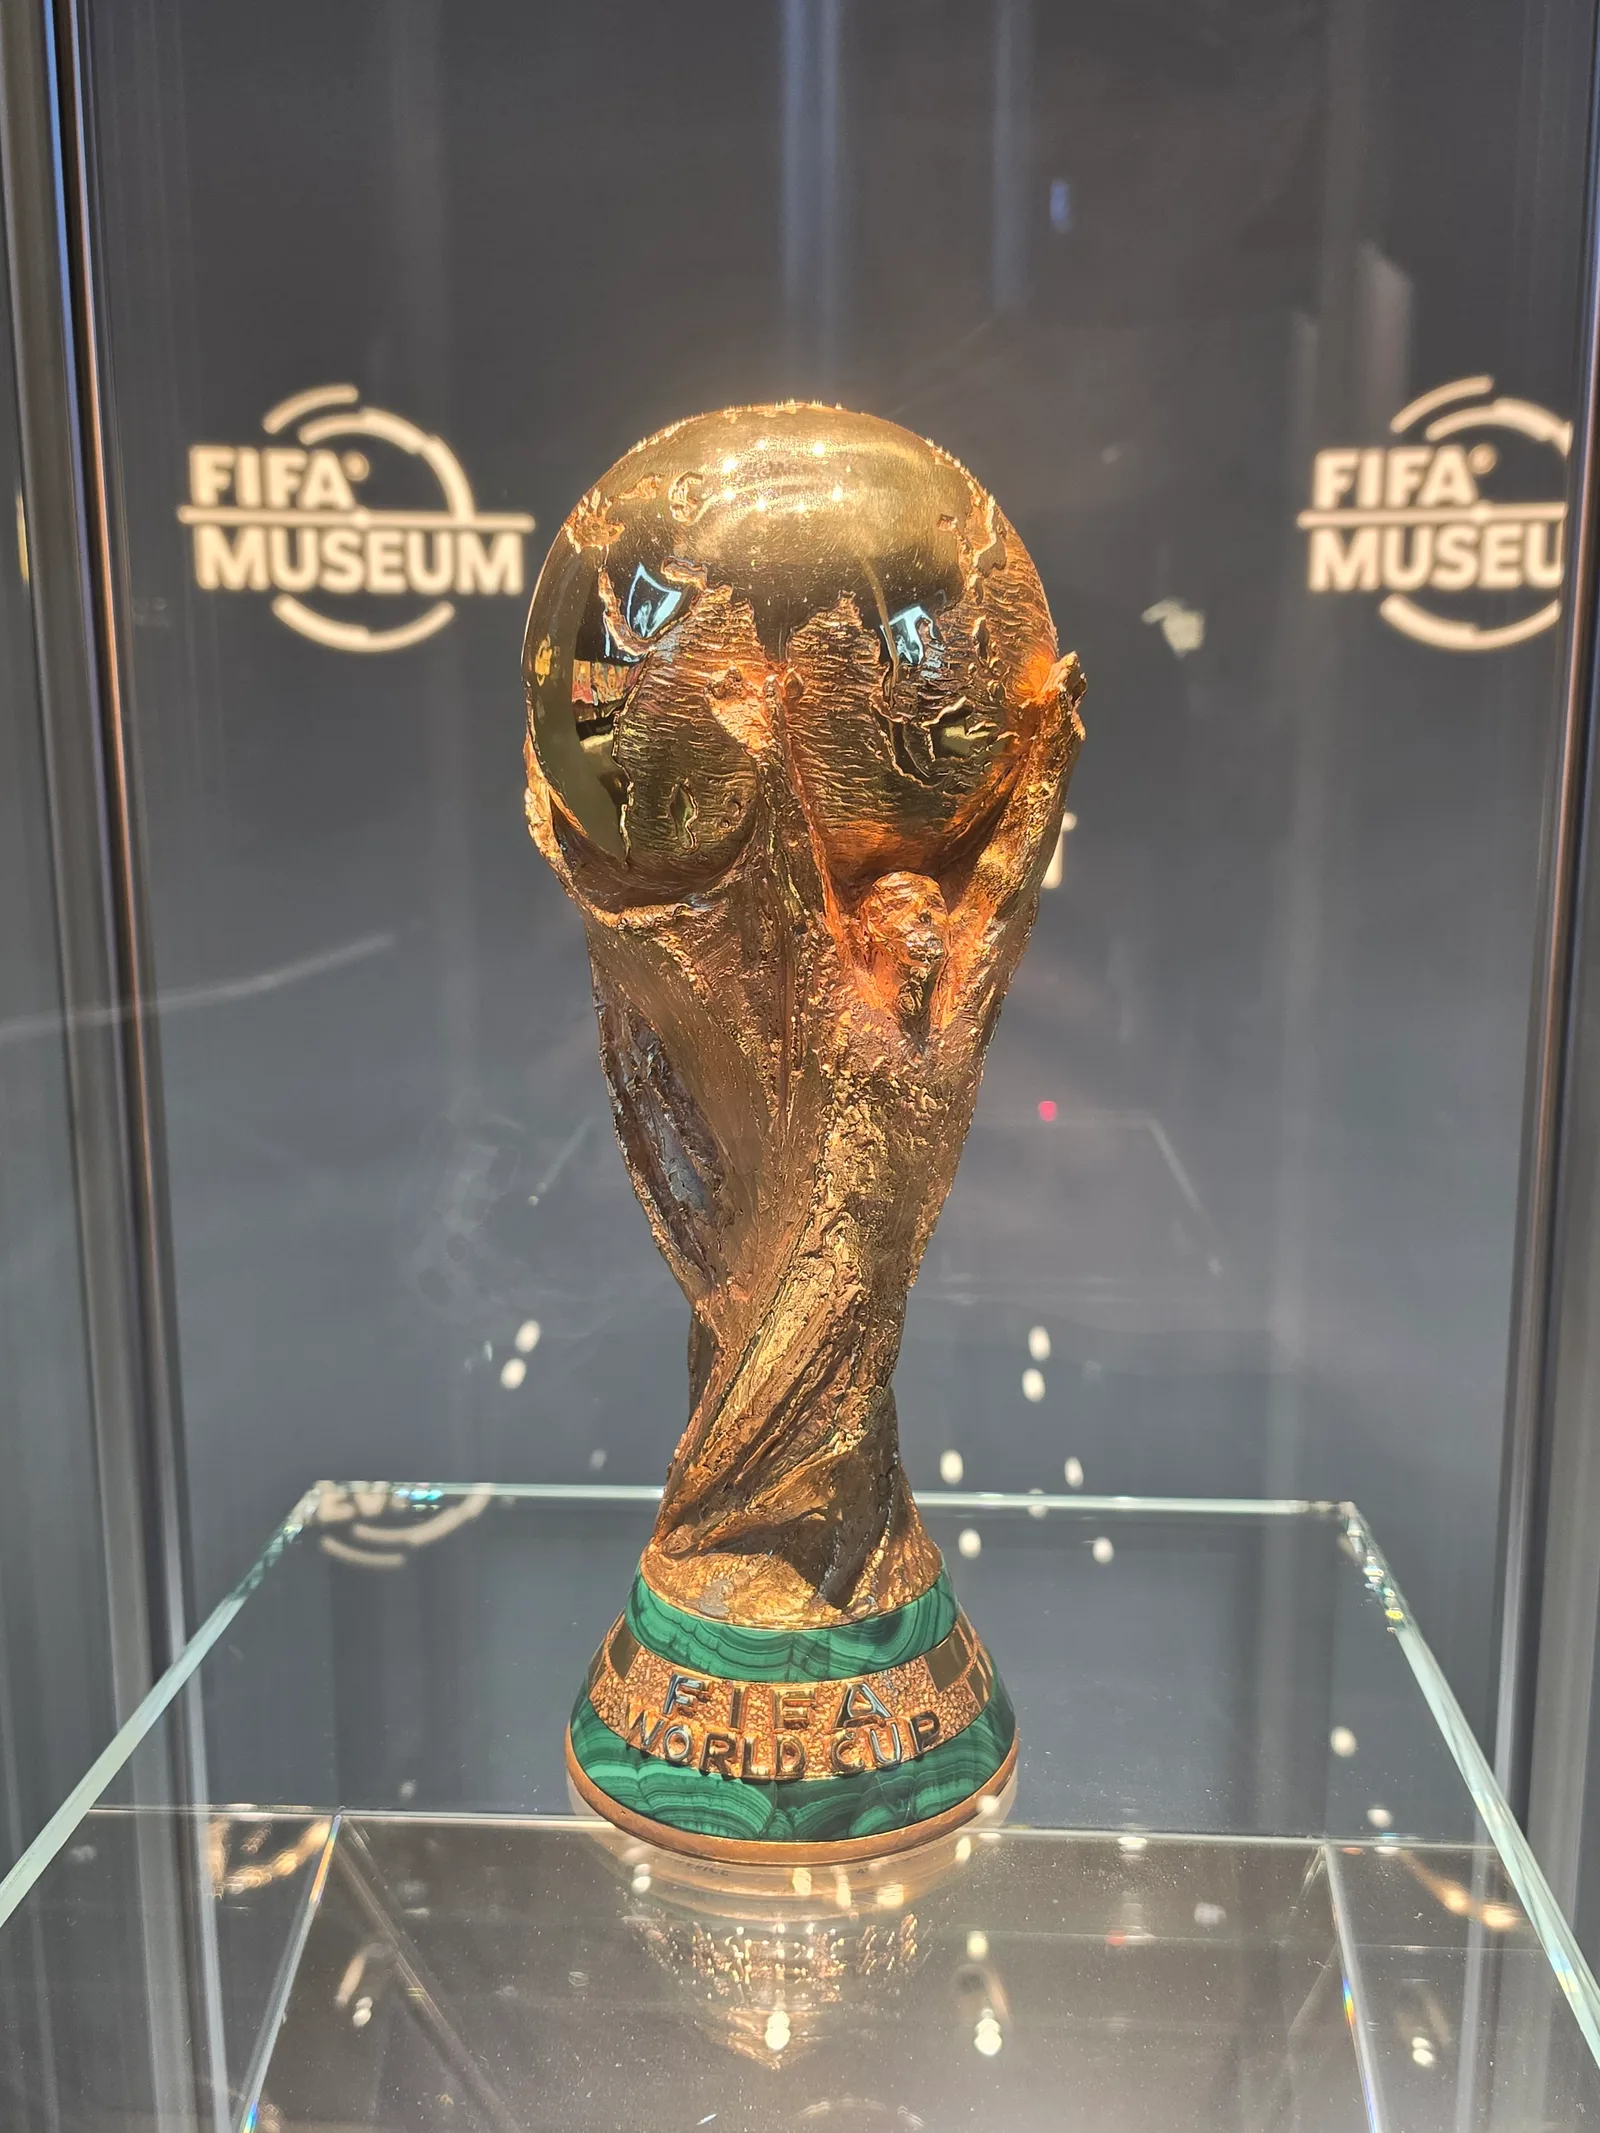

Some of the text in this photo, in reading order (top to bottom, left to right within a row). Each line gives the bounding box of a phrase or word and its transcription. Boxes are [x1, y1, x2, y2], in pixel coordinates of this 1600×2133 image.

[193, 523, 525, 595] MUSEUM
[662, 1673, 892, 1730] FIFA
[626, 1704, 940, 1780] WORLD CUP
